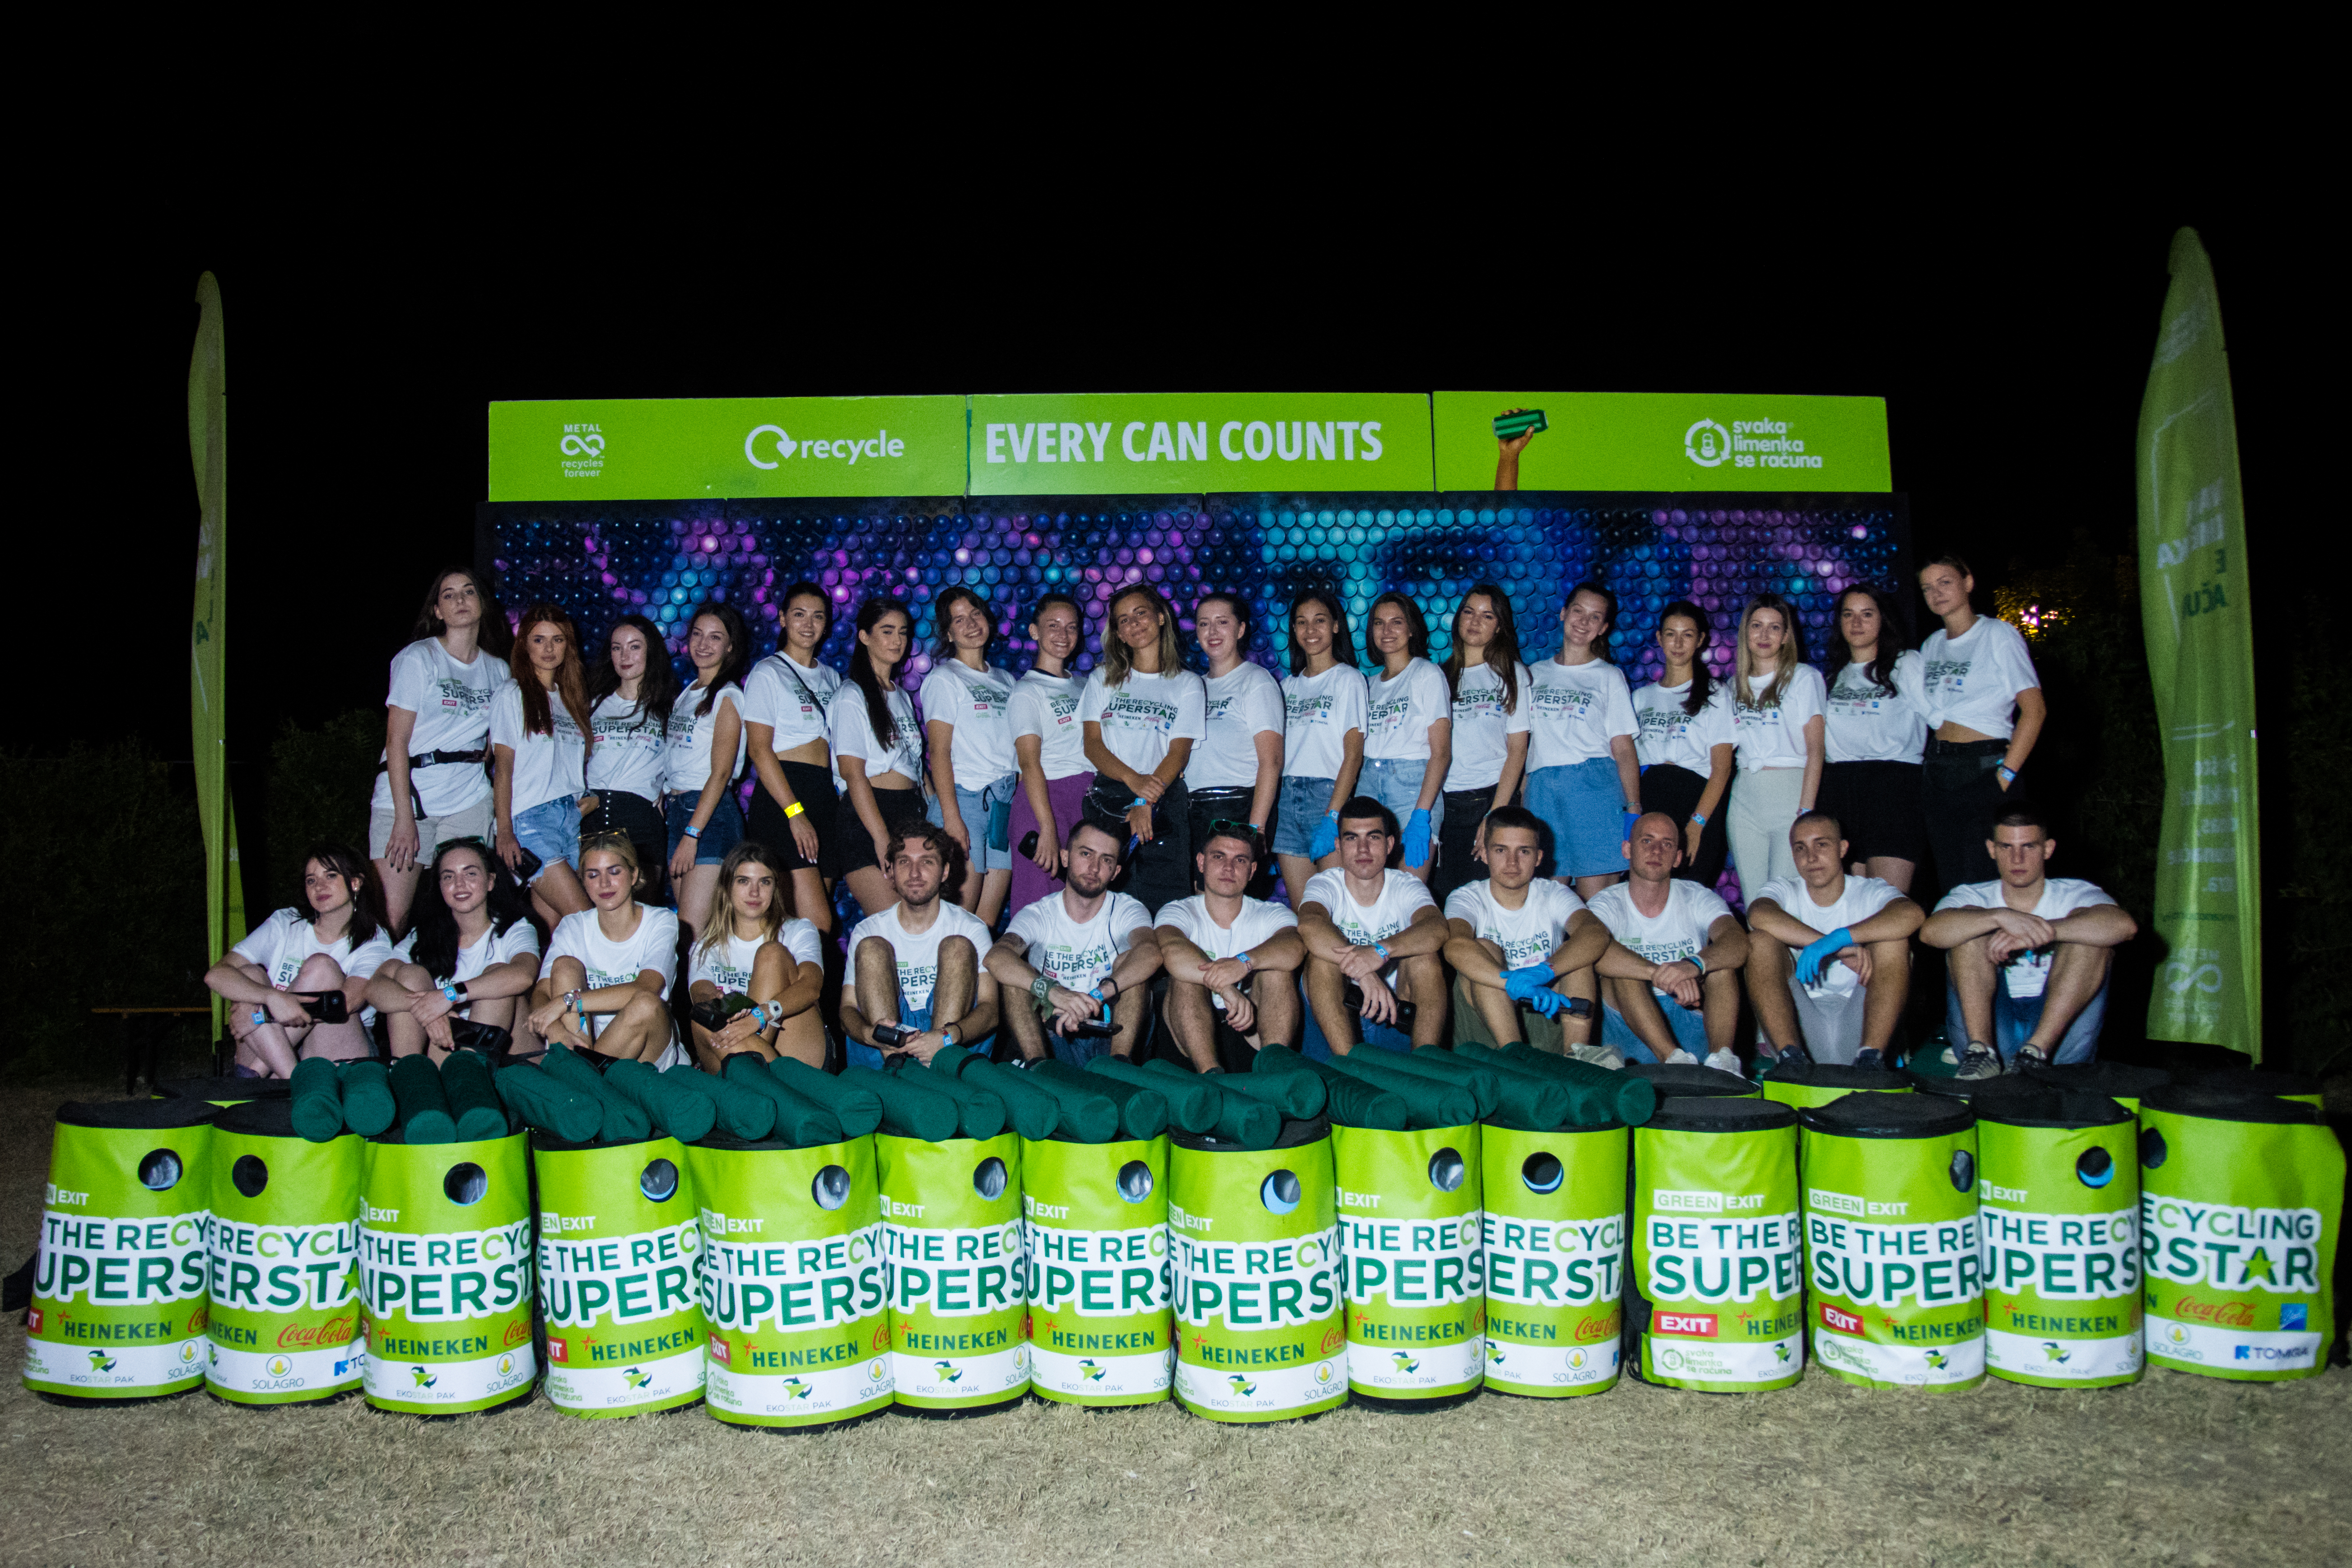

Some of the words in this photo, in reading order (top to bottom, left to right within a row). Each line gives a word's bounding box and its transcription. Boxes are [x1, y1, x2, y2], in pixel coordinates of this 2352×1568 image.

[564, 424, 601, 433] METAL
[1733, 417, 1786, 434] svaka
[801, 430, 904, 465] recycle
[987, 422, 1112, 463] EVERY
[1122, 421, 1207, 462] CAN
[1219, 421, 1382, 461] COUNTS
[1733, 435, 1804, 452] limenka
[561, 459, 603, 469] recycles
[1735, 455, 1755, 467] se
[564, 469, 601, 477] forever
[1134, 700, 1178, 713] RECYCLING
[1646, 938, 1693, 951] RECYCLING
[1057, 953, 1073, 961] THE
[282, 963, 294, 972] BE
[914, 965, 937, 974] RECY
[58, 1190, 89, 1205] EXIT
[1345, 1193, 1380, 1208] EXIT
[1658, 1194, 1718, 1208] GREEN
[1726, 1195, 1764, 1208] EXIT
[1812, 1193, 1860, 1213] GREEN
[1868, 1202, 1908, 1215] EXIT
[1993, 1187, 2027, 1202] EXIT
[370, 1208, 399, 1222] EXIT
[893, 1202, 925, 1218] EXIT
[1036, 1203, 1068, 1219] EXIT
[2142, 1197, 2314, 1240] ECYCLING
[562, 1216, 596, 1230] EXIT
[727, 1219, 764, 1232] EXIT
[1186, 1214, 1212, 1231] EXIT
[1983, 1212, 2049, 1246] THE
[47, 1217, 105, 1250] THE
[116, 1216, 210, 1250] RECY
[885, 1228, 945, 1261] THE
[956, 1222, 1024, 1261] RECY
[1339, 1221, 1400, 1251] THE
[1413, 1218, 1481, 1252] REC
[1504, 1219, 1624, 1252] RECYCL
[1653, 1222, 1698, 1249] BE
[1710, 1222, 1780, 1249] THE
[1812, 1218, 1846, 1250] BE
[1855, 1229, 1928, 1256] THE
[1939, 1222, 1974, 1253] RE
[363, 1234, 417, 1266] THE
[556, 1243, 620, 1273] THE
[631, 1227, 698, 1267] REC
[721, 1247, 786, 1276] THE
[797, 1229, 880, 1275] RECY
[1032, 1228, 1088, 1262] THE
[1100, 1228, 1169, 1262] REC
[1180, 1240, 1235, 1274] THE
[2142, 1228, 2314, 1287] RSTAR
[35, 1251, 205, 1298] UPERS
[1341, 1249, 1483, 1300] UPERS
[1490, 1252, 1619, 1300] ERST
[1816, 1250, 1980, 1301] SUPER
[1984, 1246, 2137, 1293] UPERS
[886, 1256, 1025, 1310] UPERS
[1026, 1260, 1172, 1310] UPERS
[701, 1266, 882, 1326] SUPERS
[1661, 1316, 1711, 1332] EXIT
[1825, 1307, 1857, 1331] EXIT
[1893, 1315, 1981, 1340] HEINEKEN
[2012, 1312, 2117, 1333] HEINEKEN
[65, 1321, 172, 1339] HEINEKEN
[907, 1328, 1006, 1350] HEINEKEN
[1052, 1330, 1155, 1349] HEINEKEN
[1364, 1321, 1464, 1340] HEINEKEN
[385, 1335, 488, 1355] HEINEKEN
[591, 1327, 694, 1361] HEINEKEN
[710, 1336, 727, 1358] EXIT
[753, 1340, 858, 1367] HEINEKEN
[1202, 1343, 1304, 1364] HEINEKEN
[2152, 1341, 2203, 1360] SOLAGRO
[2254, 1347, 2309, 1359] TOMRA
[71, 1374, 111, 1383] EKOSTAR
[252, 1378, 304, 1389] SOLAGRO
[486, 1373, 523, 1393] SOLAGRO
[1374, 1376, 1416, 1384] EKOSTAR
[1504, 1371, 1521, 1379] PAK
[1553, 1371, 1597, 1382] SOLAGRO
[396, 1390, 433, 1399] EKOSTAR
[607, 1392, 649, 1404] EKOSTAR
[653, 1387, 671, 1396] PAK
[917, 1385, 958, 1393] EKOSTAR
[1062, 1382, 1102, 1391] EKOSTAR
[1105, 1384, 1123, 1392] PAK
[1304, 1381, 1342, 1400] SOLAGRO
[767, 1403, 809, 1412] EKOSTAR
[813, 1400, 831, 1410] PAK
[1211, 1399, 1253, 1407] EKOSTAR
